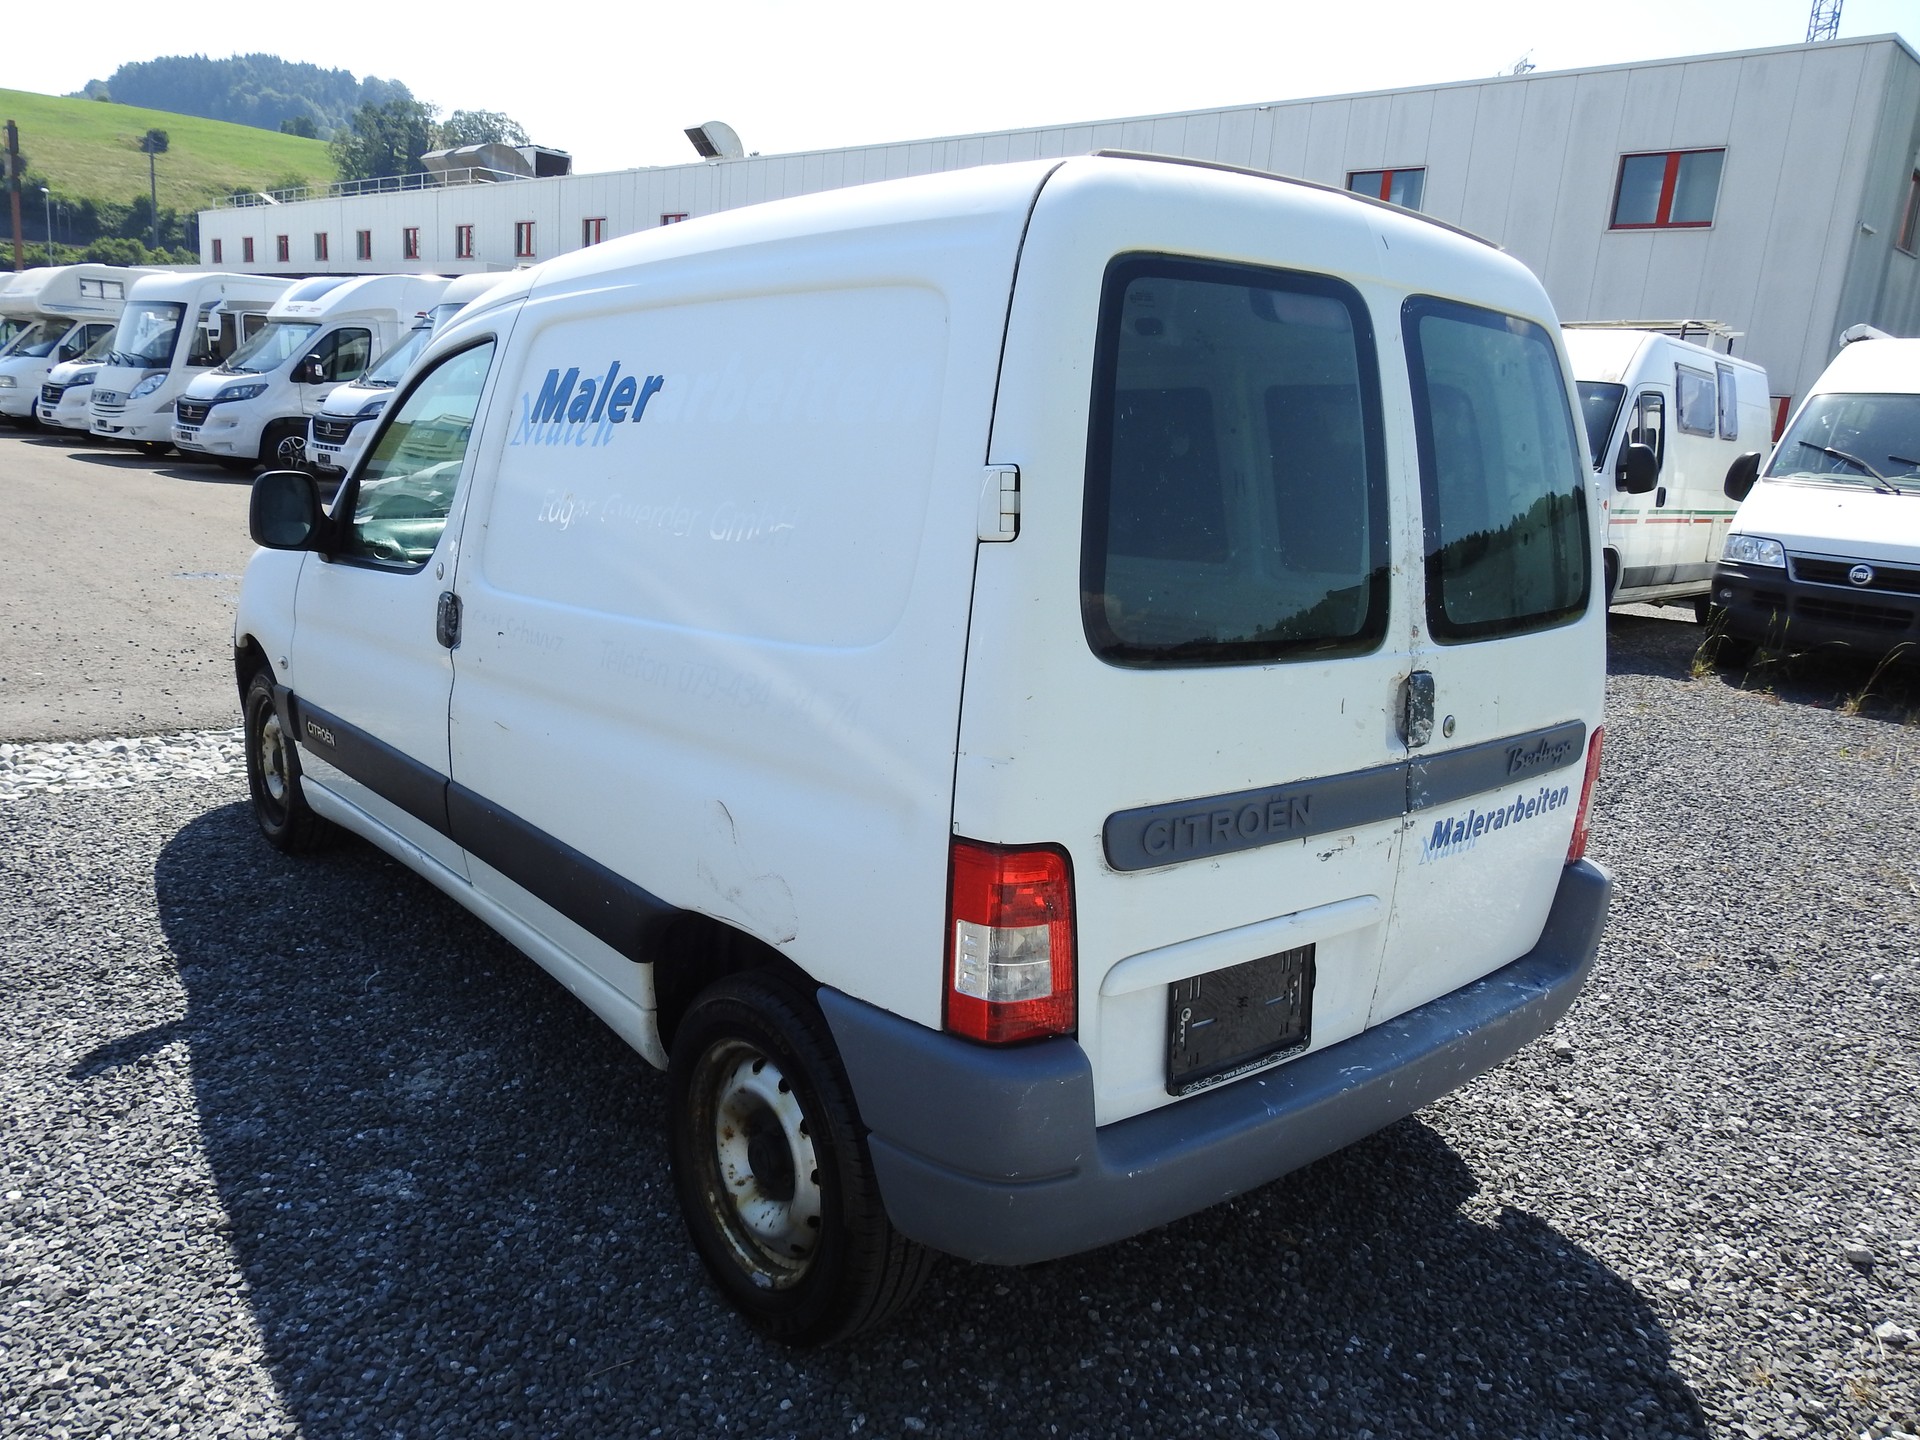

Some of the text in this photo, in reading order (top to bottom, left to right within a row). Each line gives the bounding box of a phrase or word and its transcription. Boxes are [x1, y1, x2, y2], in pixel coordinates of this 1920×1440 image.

[306, 721, 336, 747] CITROËN
[1505, 738, 1572, 777] Berlingo
[1143, 793, 1313, 857] CITROËN
[1429, 785, 1569, 851] Malerarbeiten
